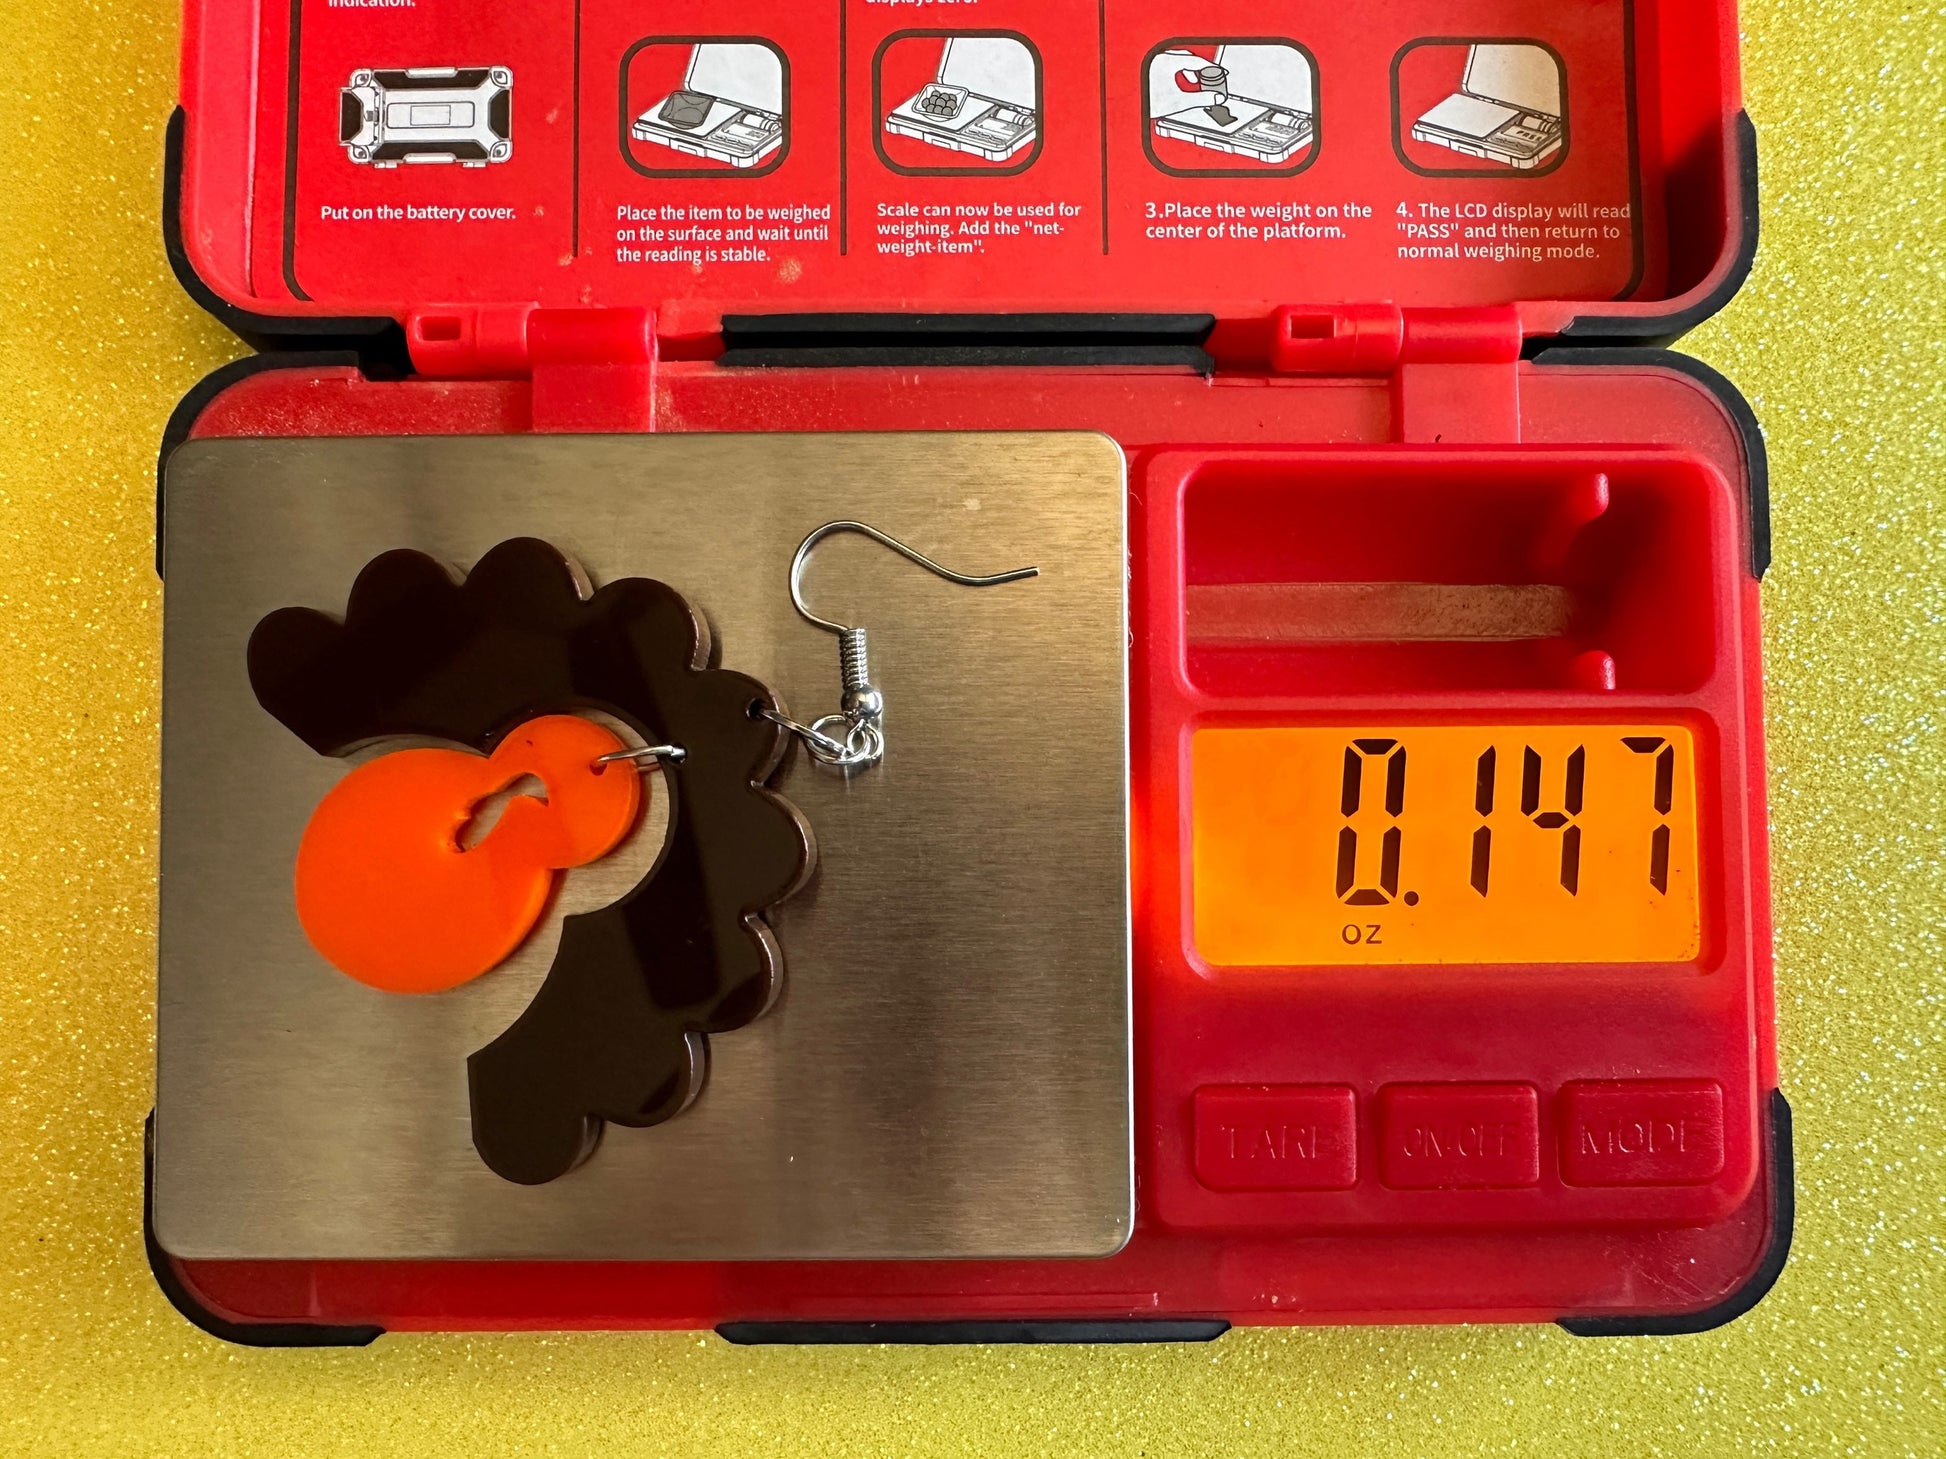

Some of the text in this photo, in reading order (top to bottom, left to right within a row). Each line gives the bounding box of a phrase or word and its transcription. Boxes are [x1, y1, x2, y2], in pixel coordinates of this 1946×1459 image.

[321, 204, 516, 222] Put on the battery cover.
[617, 204, 830, 223] Place the item to be weighed
[877, 202, 1081, 217] Scale can now be used for
[1145, 202, 1372, 221] 3.Place the weight on the
[1396, 201, 1631, 222] 4. The LCD display will read
[616, 225, 829, 241] on the surface and wait until
[877, 221, 1064, 238] weighing. Add the "net-
[1146, 222, 1346, 242] center of the platform.
[1397, 223, 1620, 239] "PASS" and then return to
[616, 246, 770, 265] the reading is stable.
[877, 239, 985, 257] weight-item".
[1398, 242, 1600, 262] normal weighing mode.
[1335, 737, 1675, 907] 0.147
